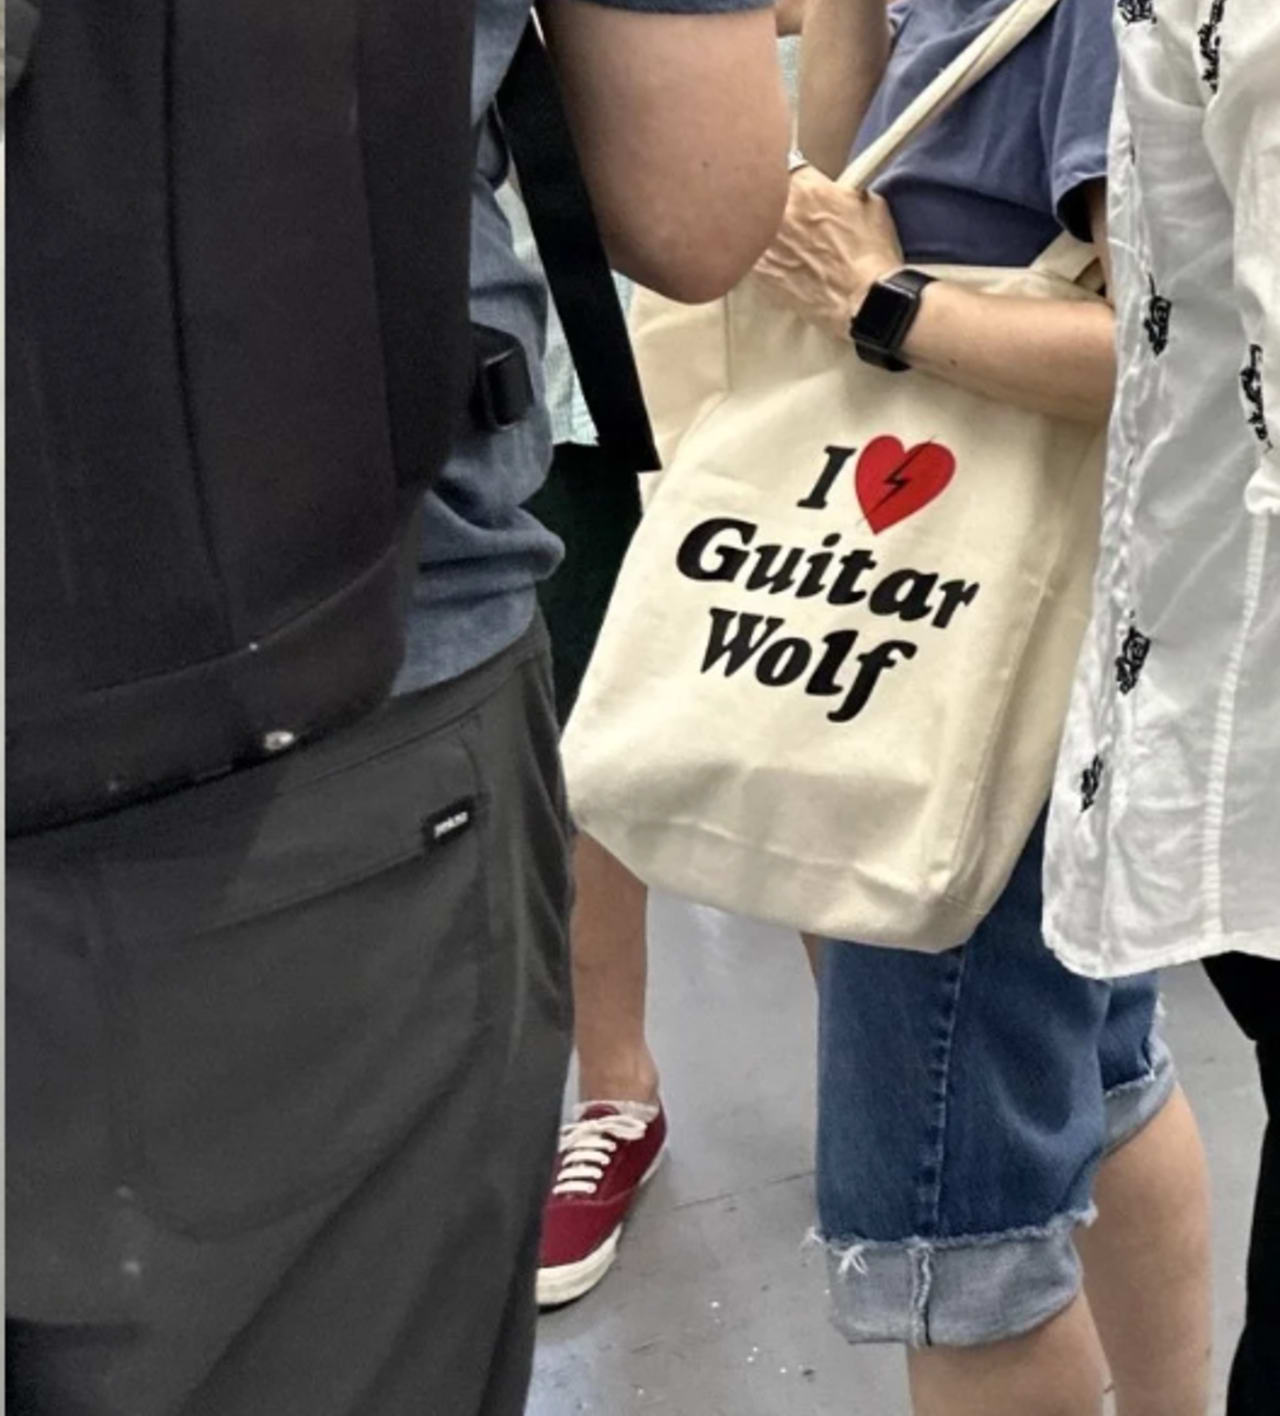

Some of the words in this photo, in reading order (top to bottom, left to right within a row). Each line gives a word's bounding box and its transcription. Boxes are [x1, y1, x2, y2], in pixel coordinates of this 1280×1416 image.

[797, 445, 857, 510] I
[676, 517, 980, 630] Guitar
[701, 606, 917, 723] Wolf
